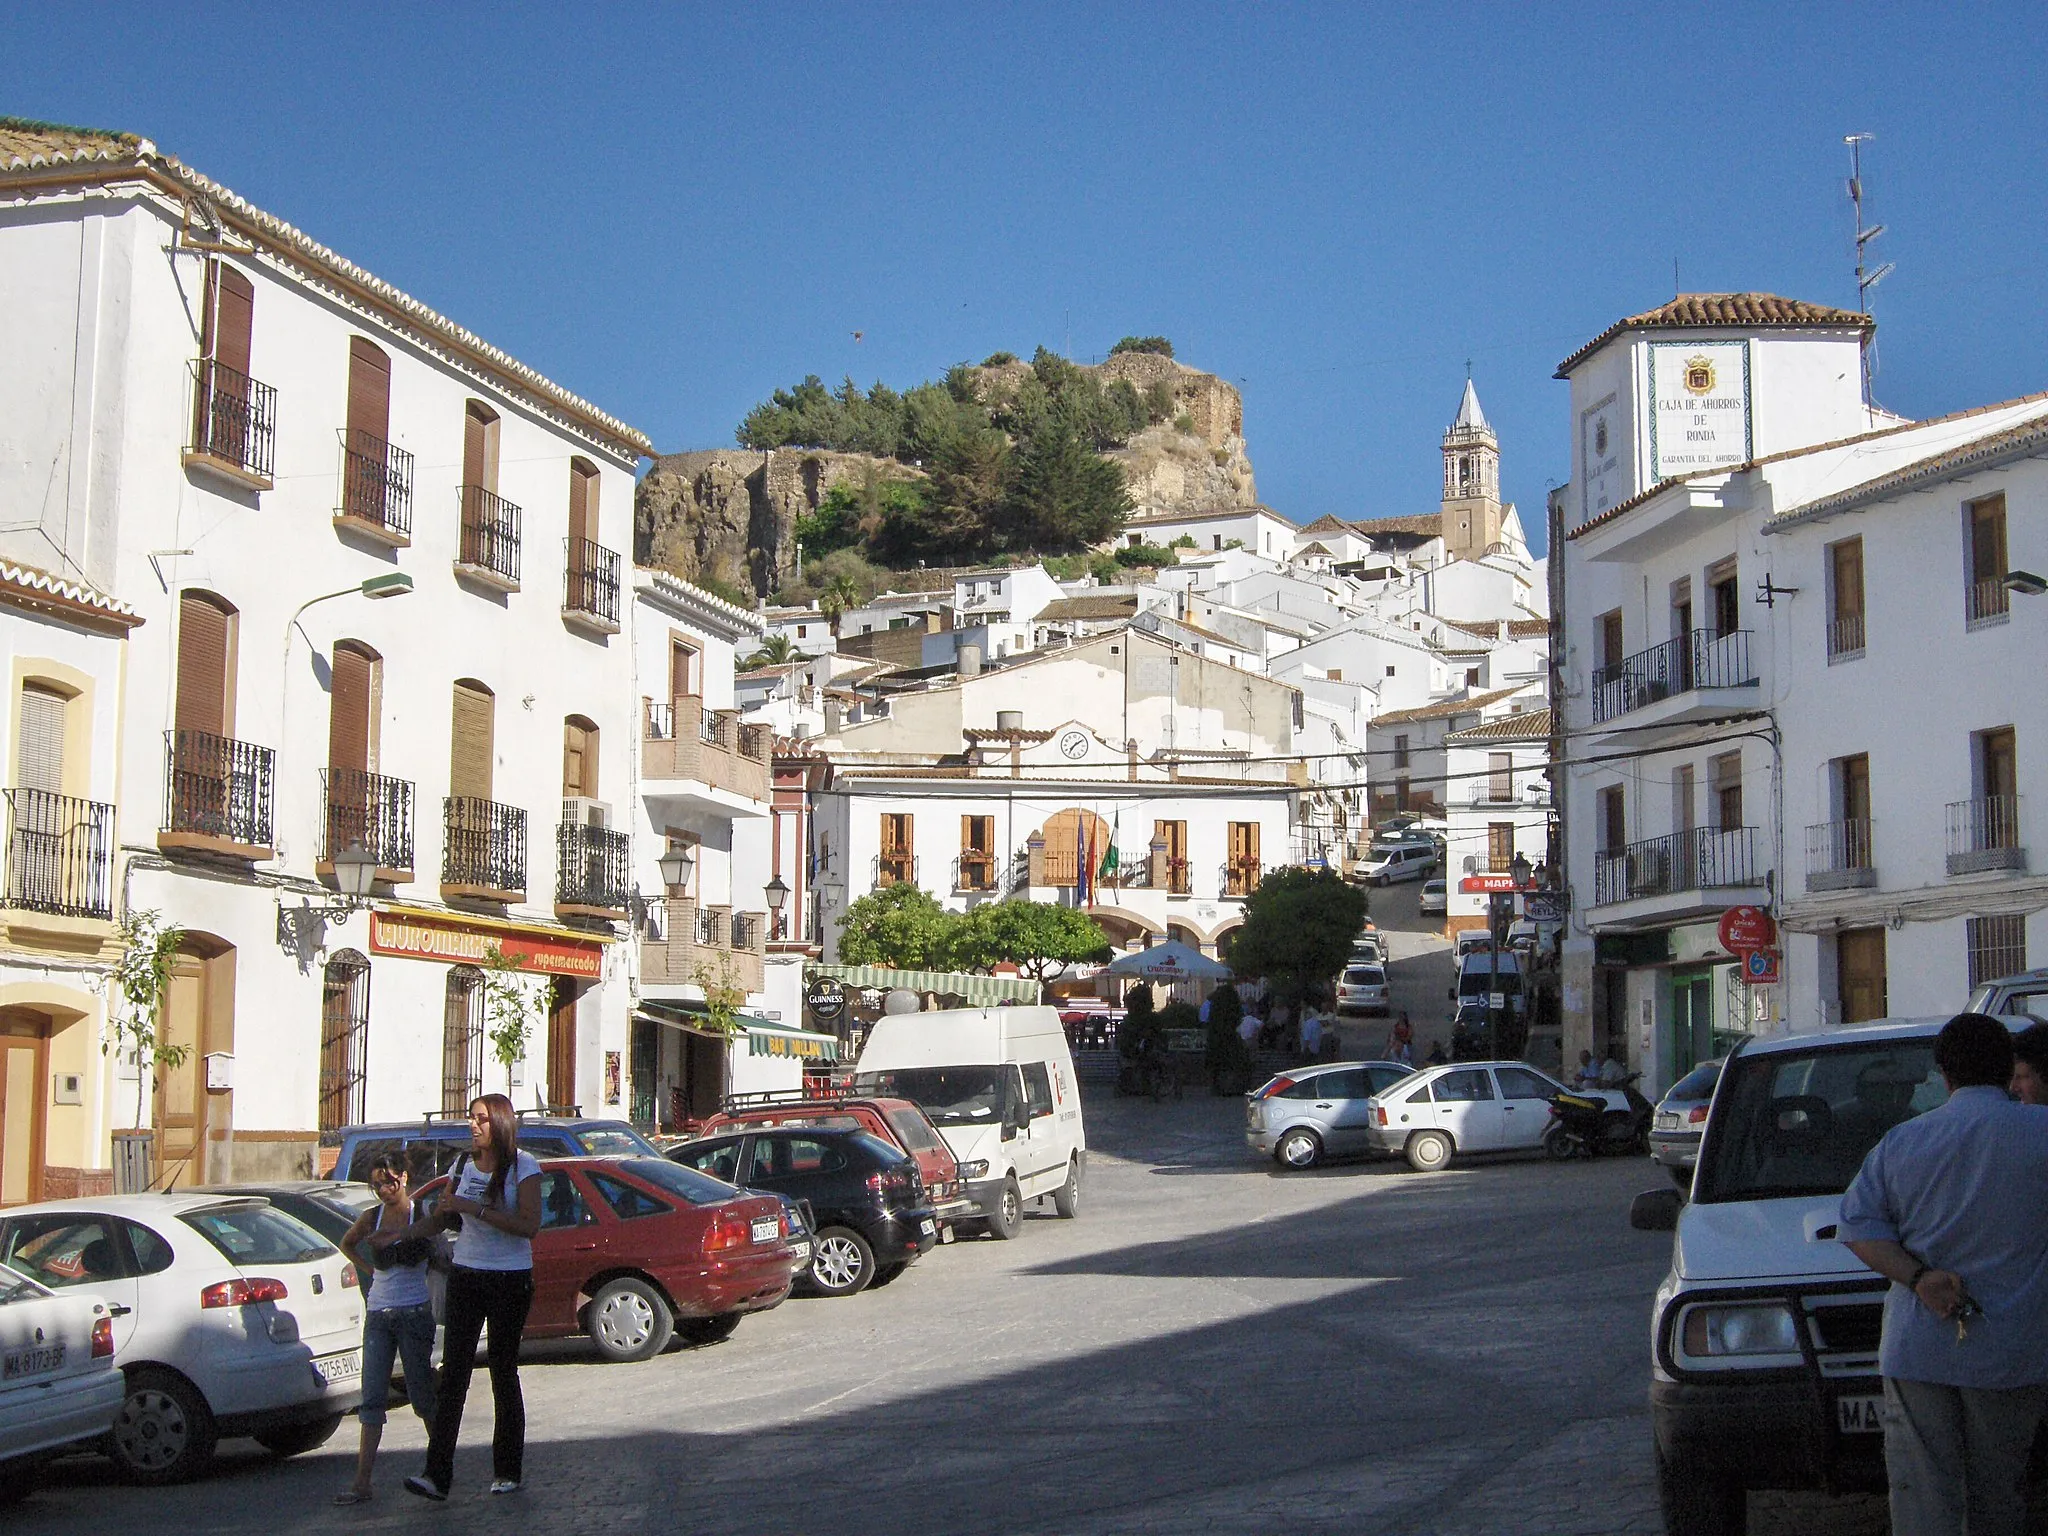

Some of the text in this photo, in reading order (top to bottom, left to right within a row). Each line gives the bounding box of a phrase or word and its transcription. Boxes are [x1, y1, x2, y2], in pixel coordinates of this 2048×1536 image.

[1659, 399, 1741, 411] CAJA DE AHORROS
[1694, 415, 1707, 425] DE
[1687, 431, 1716, 441] RONDA
[1698, 455, 1712, 463] DEL
[1715, 454, 1742, 462] AHORRO
[375, 915, 503, 959] LAUROMARKET
[534, 953, 600, 972] supermercados
[1147, 965, 1184, 974] Cruzcampo
[809, 995, 843, 1003] GUINNESS
[769, 1037, 785, 1053] BAR
[319, 1356, 360, 1378] 3756 BVL
